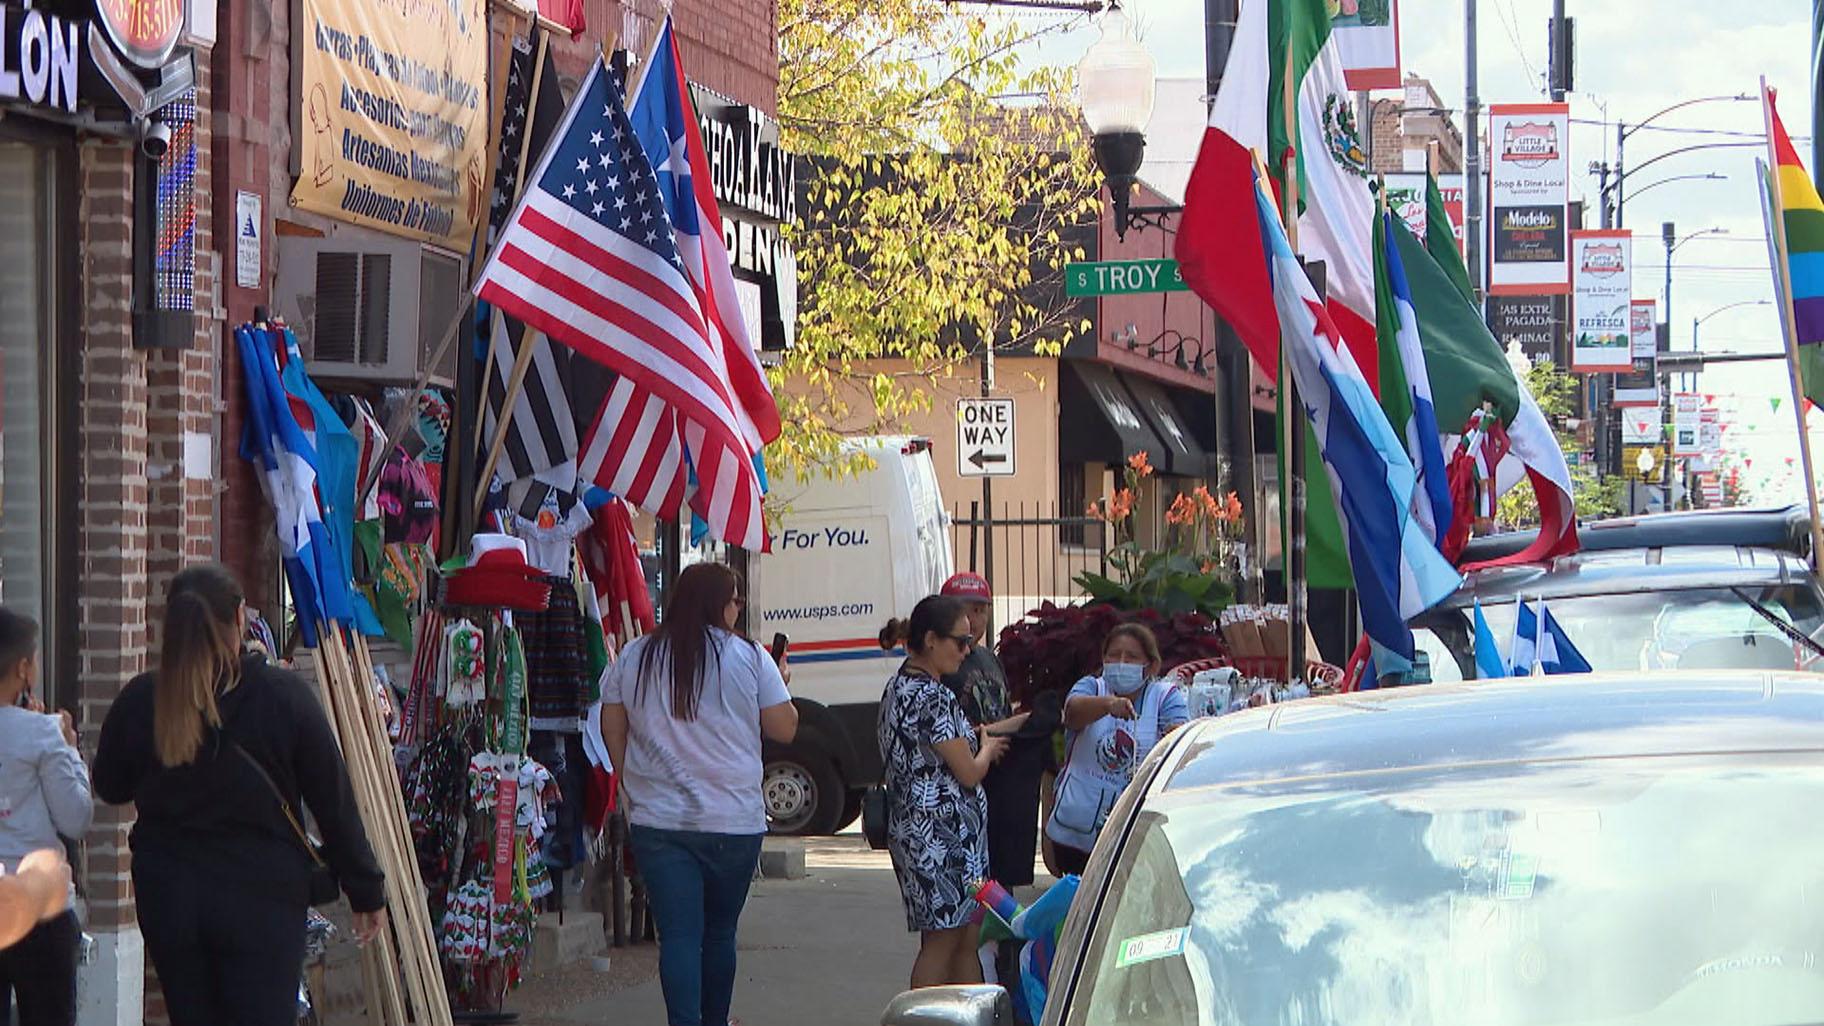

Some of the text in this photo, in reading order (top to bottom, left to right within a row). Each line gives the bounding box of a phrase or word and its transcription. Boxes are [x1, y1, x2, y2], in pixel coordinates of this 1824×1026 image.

[1514, 144, 1546, 153] VILLAGE
[1519, 137, 1541, 145] LITTLE
[341, 179, 405, 225] Uniformes
[1508, 210, 1550, 228] Modelo
[1078, 273, 1087, 288] S
[1094, 264, 1161, 291] TROY
[1520, 304, 1552, 314] EXTR
[1580, 318, 1625, 327] REFRESCA
[965, 405, 1007, 424] ONE
[964, 426, 1008, 445] WAY
[782, 529, 820, 550] For
[824, 526, 869, 547] You.
[763, 603, 873, 621] www.usps.com
